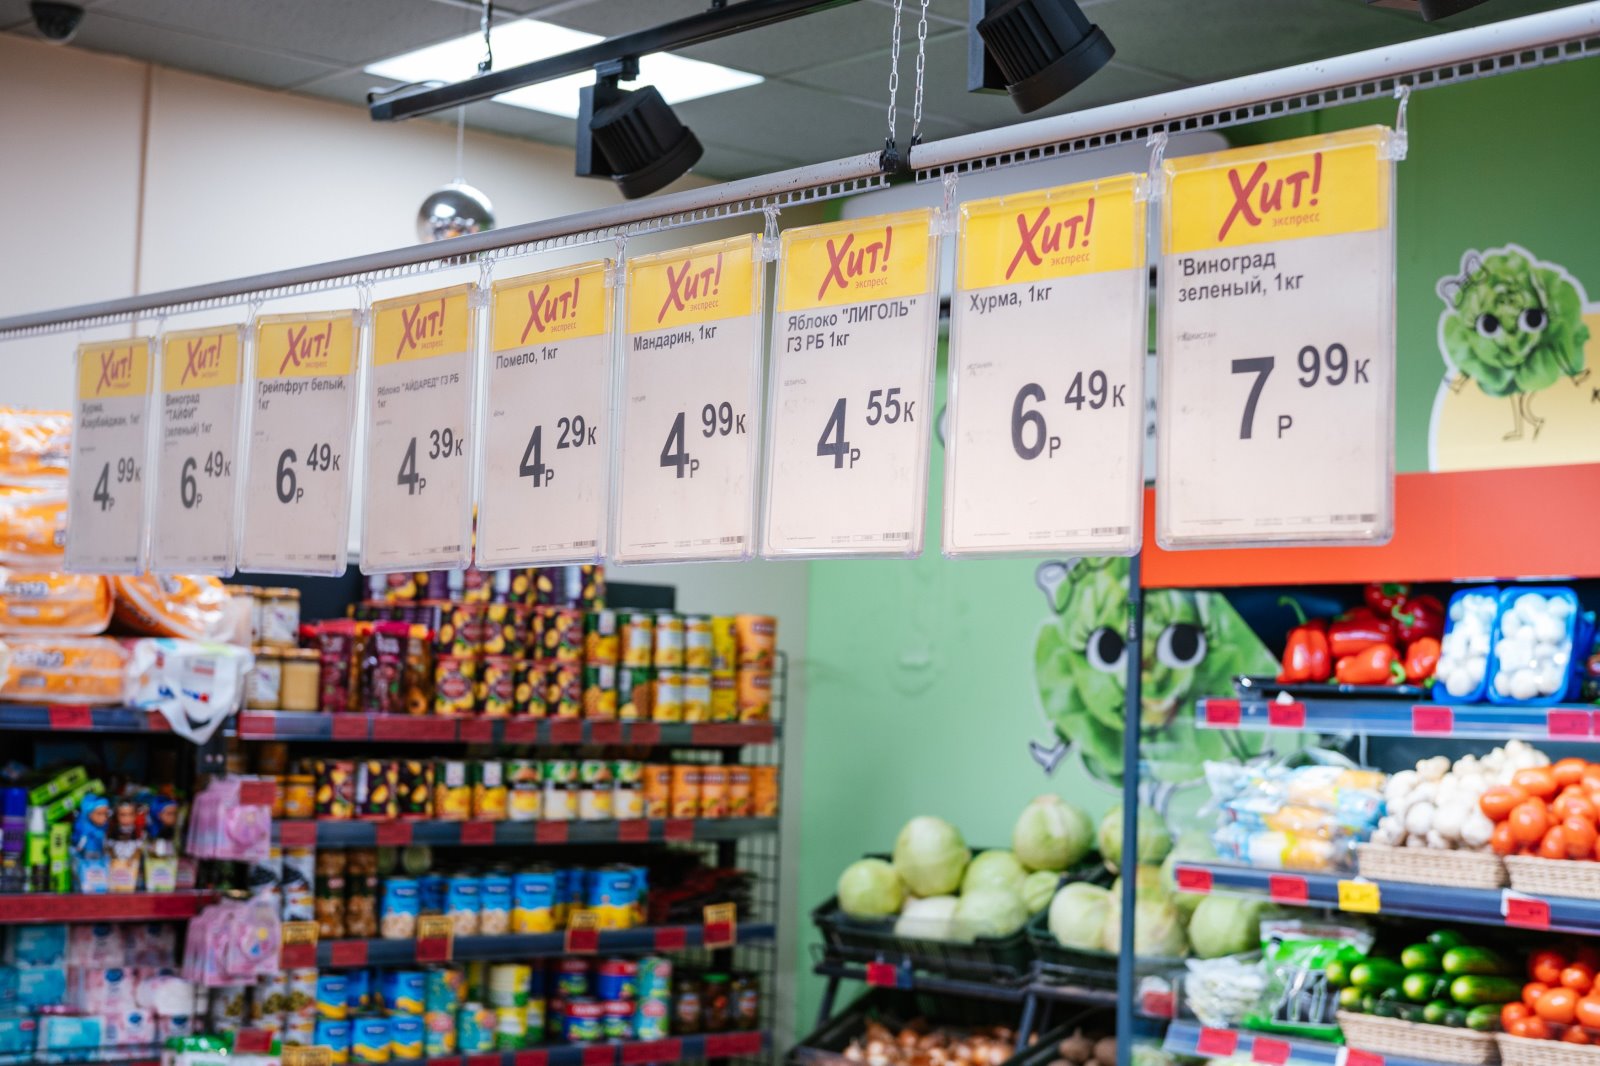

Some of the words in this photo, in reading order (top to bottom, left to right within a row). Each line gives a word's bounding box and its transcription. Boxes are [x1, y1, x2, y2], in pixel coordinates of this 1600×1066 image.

[1217, 152, 1323, 242] Хит!
[1271, 211, 1320, 228] экспресс
[1005, 197, 1095, 280] Хит!
[818, 225, 893, 301] Хит!
[1050, 253, 1091, 266] экспресс
[657, 251, 723, 324] Хит!
[855, 276, 888, 289] экспресс
[1178, 275, 1268, 302] зеленый,
[1274, 273, 1304, 291] 1кг
[521, 277, 580, 344] Хит!
[689, 299, 719, 312] экспресс
[969, 292, 1022, 314] Хурма,
[1028, 285, 1053, 302] 1кг
[396, 298, 446, 360] Хит!
[788, 313, 838, 332] Яблоко
[842, 299, 917, 324] "ЛИГОЛЬ"
[279, 321, 333, 375] Хит!
[633, 331, 695, 352] Мандарин,
[699, 325, 718, 340] 1кг
[806, 333, 824, 350] РБ
[829, 331, 850, 347] 1кг
[96, 346, 133, 396] Хит!
[181, 334, 222, 385] Хит!
[496, 352, 538, 370] Помело,
[541, 346, 558, 361] 1кг
[258, 380, 309, 396] Грейпфрут
[311, 377, 346, 391] белый,
[258, 399, 270, 410] 1кг
